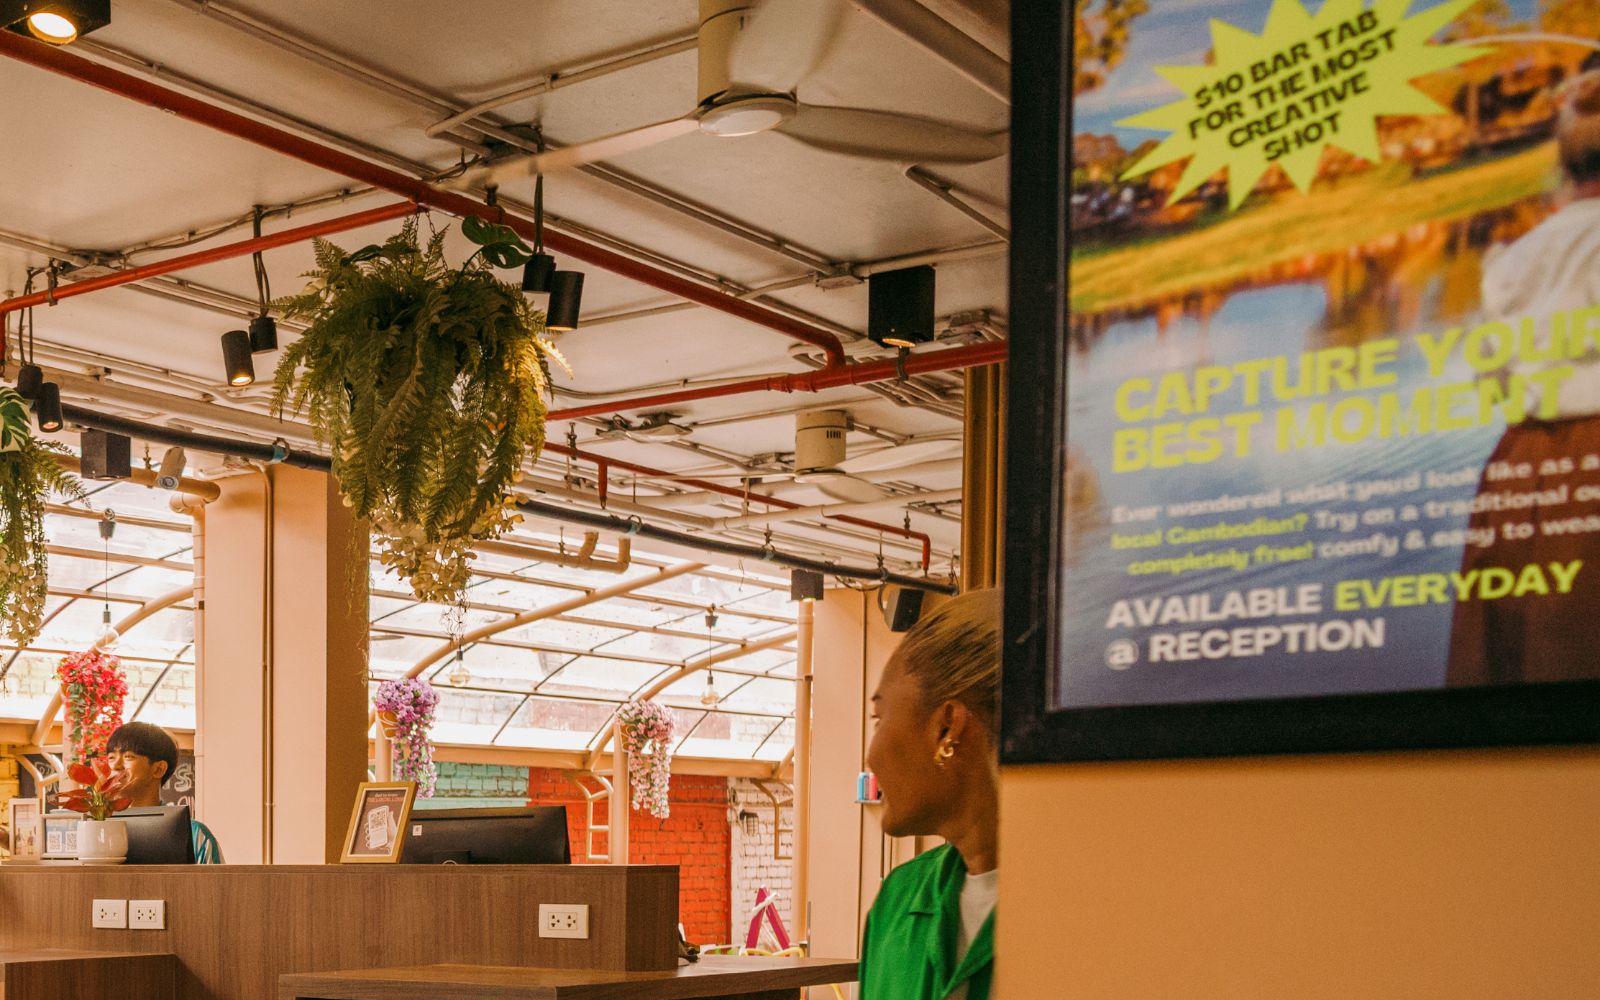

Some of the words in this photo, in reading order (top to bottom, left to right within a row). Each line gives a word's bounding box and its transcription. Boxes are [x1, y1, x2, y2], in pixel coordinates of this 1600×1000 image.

[1250, 42, 1311, 83] BAR
[1315, 10, 1378, 50] TAB
[1188, 101, 1245, 140] FOR
[1249, 72, 1307, 109] THE
[1311, 28, 1396, 83] MOST
[1228, 71, 1370, 148] CREATIVE
[1264, 111, 1341, 161] SHOT
[1114, 338, 1400, 423] CAPTURE
[1416, 304, 1600, 378] YOUR
[1112, 411, 1263, 474] BEST
[1275, 366, 1574, 454] MOMENT
[1111, 528, 1162, 549] local
[1166, 512, 1309, 545] Cambodian?
[1314, 509, 1358, 532] Try
[1361, 507, 1395, 525] on
[1401, 504, 1419, 521] a
[1423, 484, 1568, 518] traditional
[1112, 504, 1162, 523] Ever
[1167, 488, 1281, 518] wondered
[1286, 481, 1346, 504] what
[1426, 468, 1479, 489] look
[1487, 461, 1532, 481] like
[1539, 457, 1574, 475] as
[1127, 549, 1249, 576] completely
[1320, 531, 1398, 557] comfy
[1403, 529, 1426, 550] &
[1431, 526, 1496, 548] easy
[1502, 521, 1535, 540] to
[1105, 584, 1322, 629] AVAILABLE
[1334, 560, 1584, 612] EVERYDAY
[1148, 617, 1386, 663] RECEPTION
